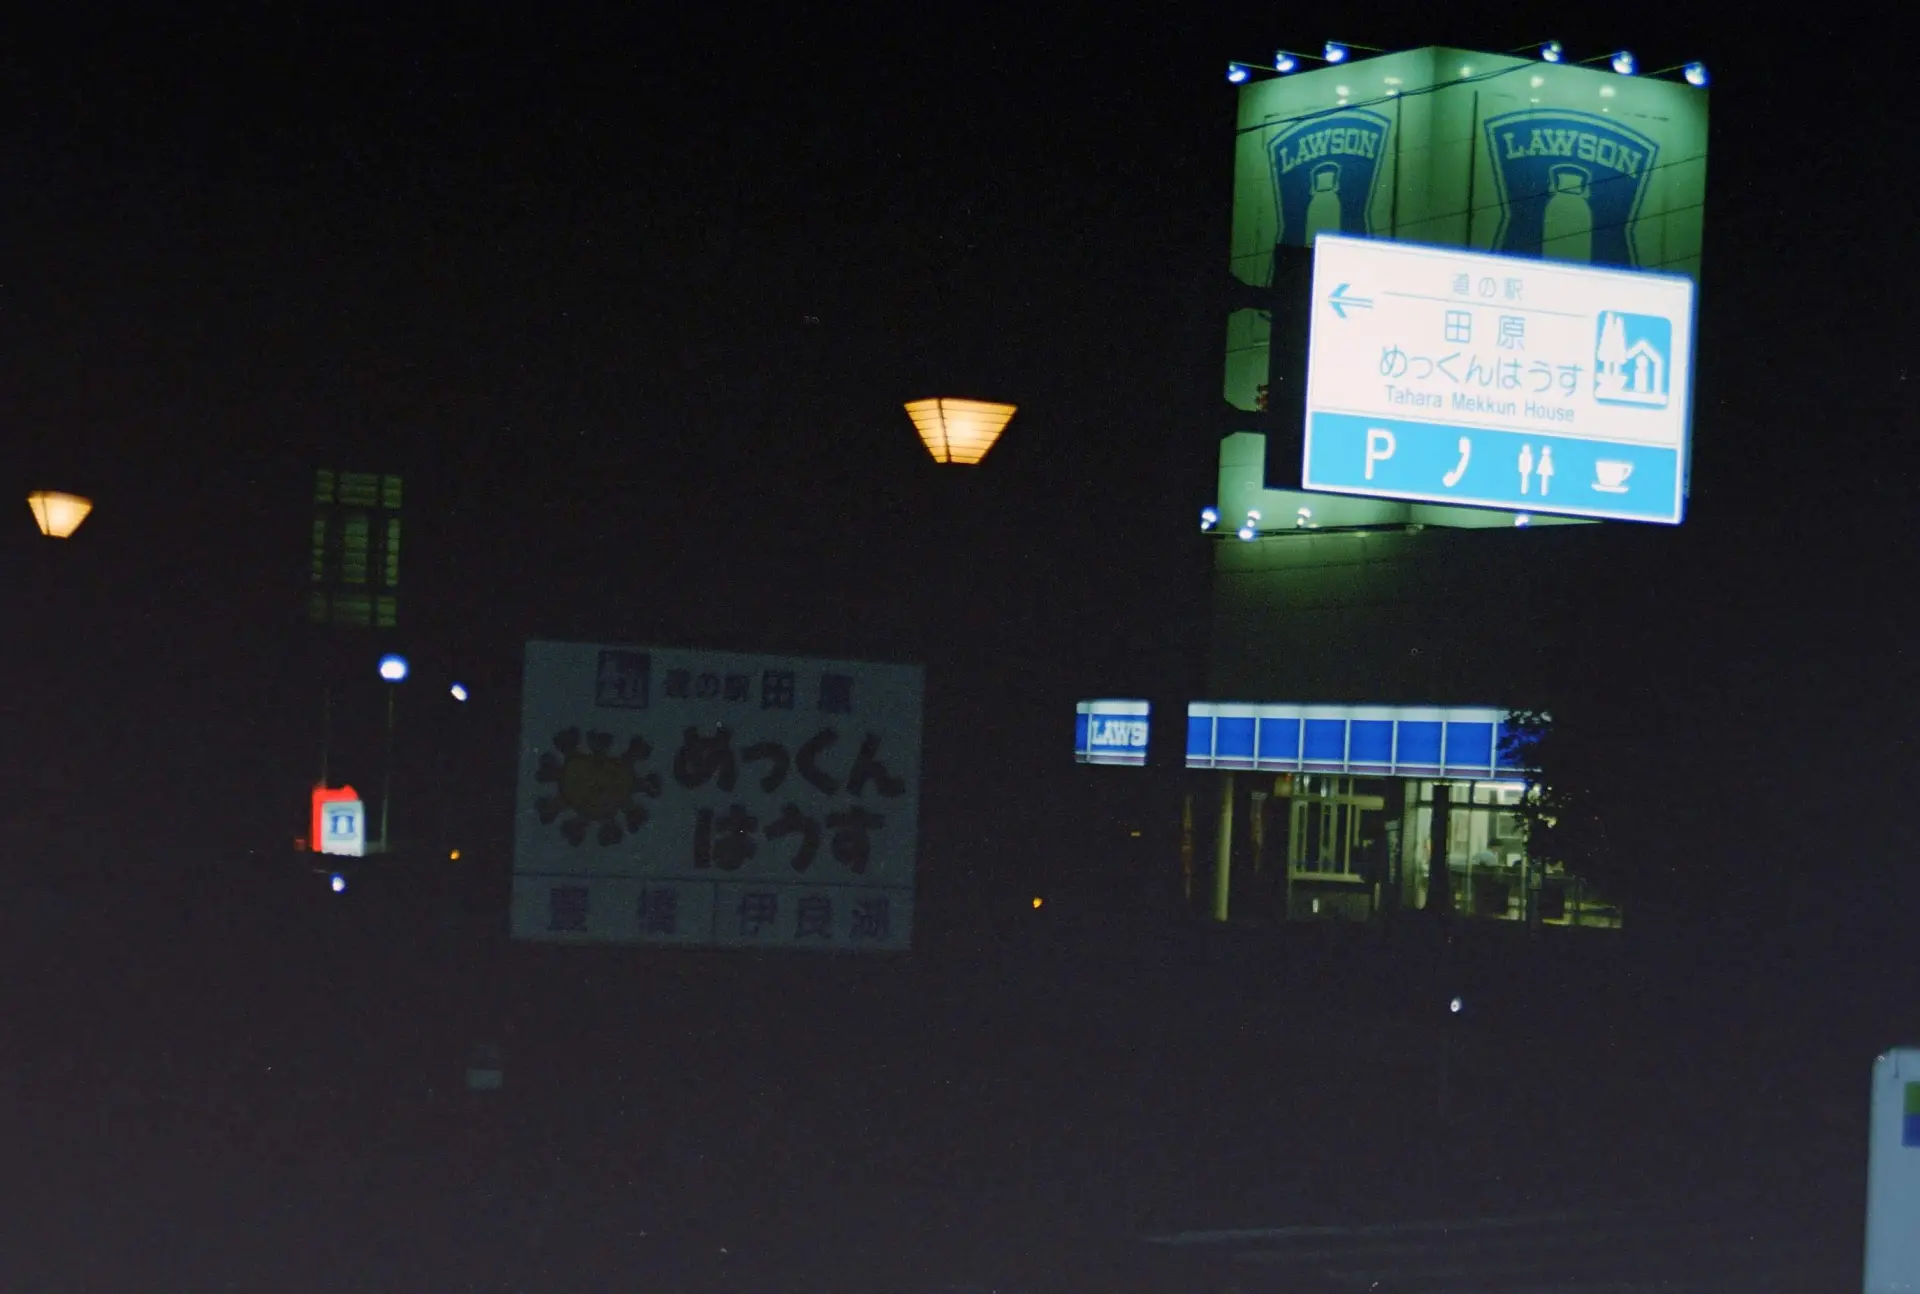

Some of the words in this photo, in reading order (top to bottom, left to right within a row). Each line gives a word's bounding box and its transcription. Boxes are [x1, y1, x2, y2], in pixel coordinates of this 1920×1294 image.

[1280, 127, 1379, 174] LAWSON
[1503, 128, 1644, 180] LAWSON
[1452, 271, 1524, 300] 道の駅
[1444, 309, 1526, 351] 田原
[1379, 343, 1585, 398] めっくんはうす
[1384, 383, 1443, 409] Tahara
[1451, 391, 1517, 417] Mekkun
[1524, 400, 1576, 423] House
[1364, 427, 1397, 480] P
[672, 725, 906, 799] めっくん
[693, 804, 887, 876] はうす
